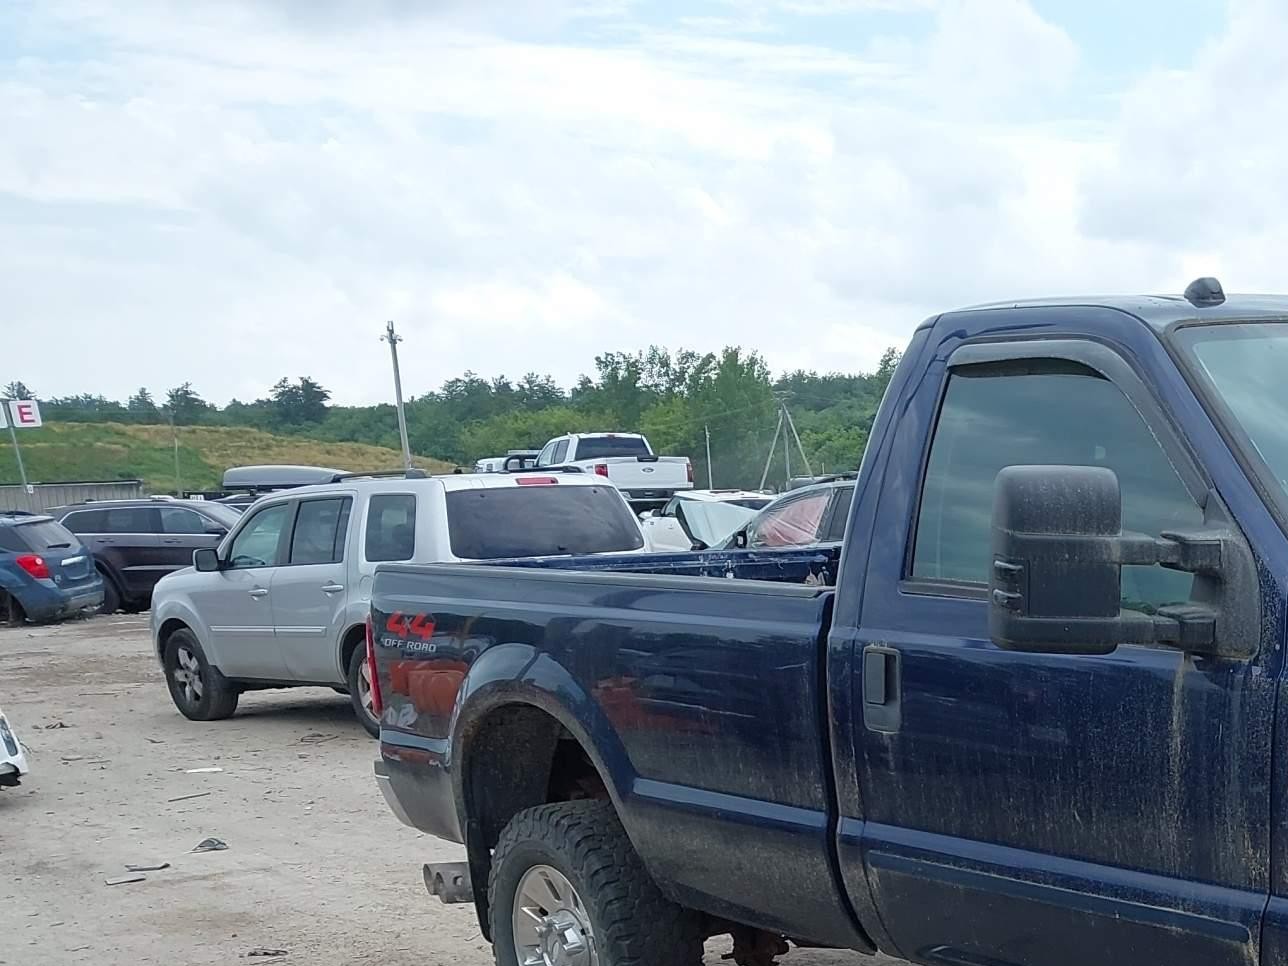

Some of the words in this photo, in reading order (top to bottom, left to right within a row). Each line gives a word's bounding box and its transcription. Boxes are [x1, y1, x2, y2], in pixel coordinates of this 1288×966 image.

[17, 404, 35, 423] E
[384, 638, 404, 648] OFF
[406, 641, 437, 653] ROAD
